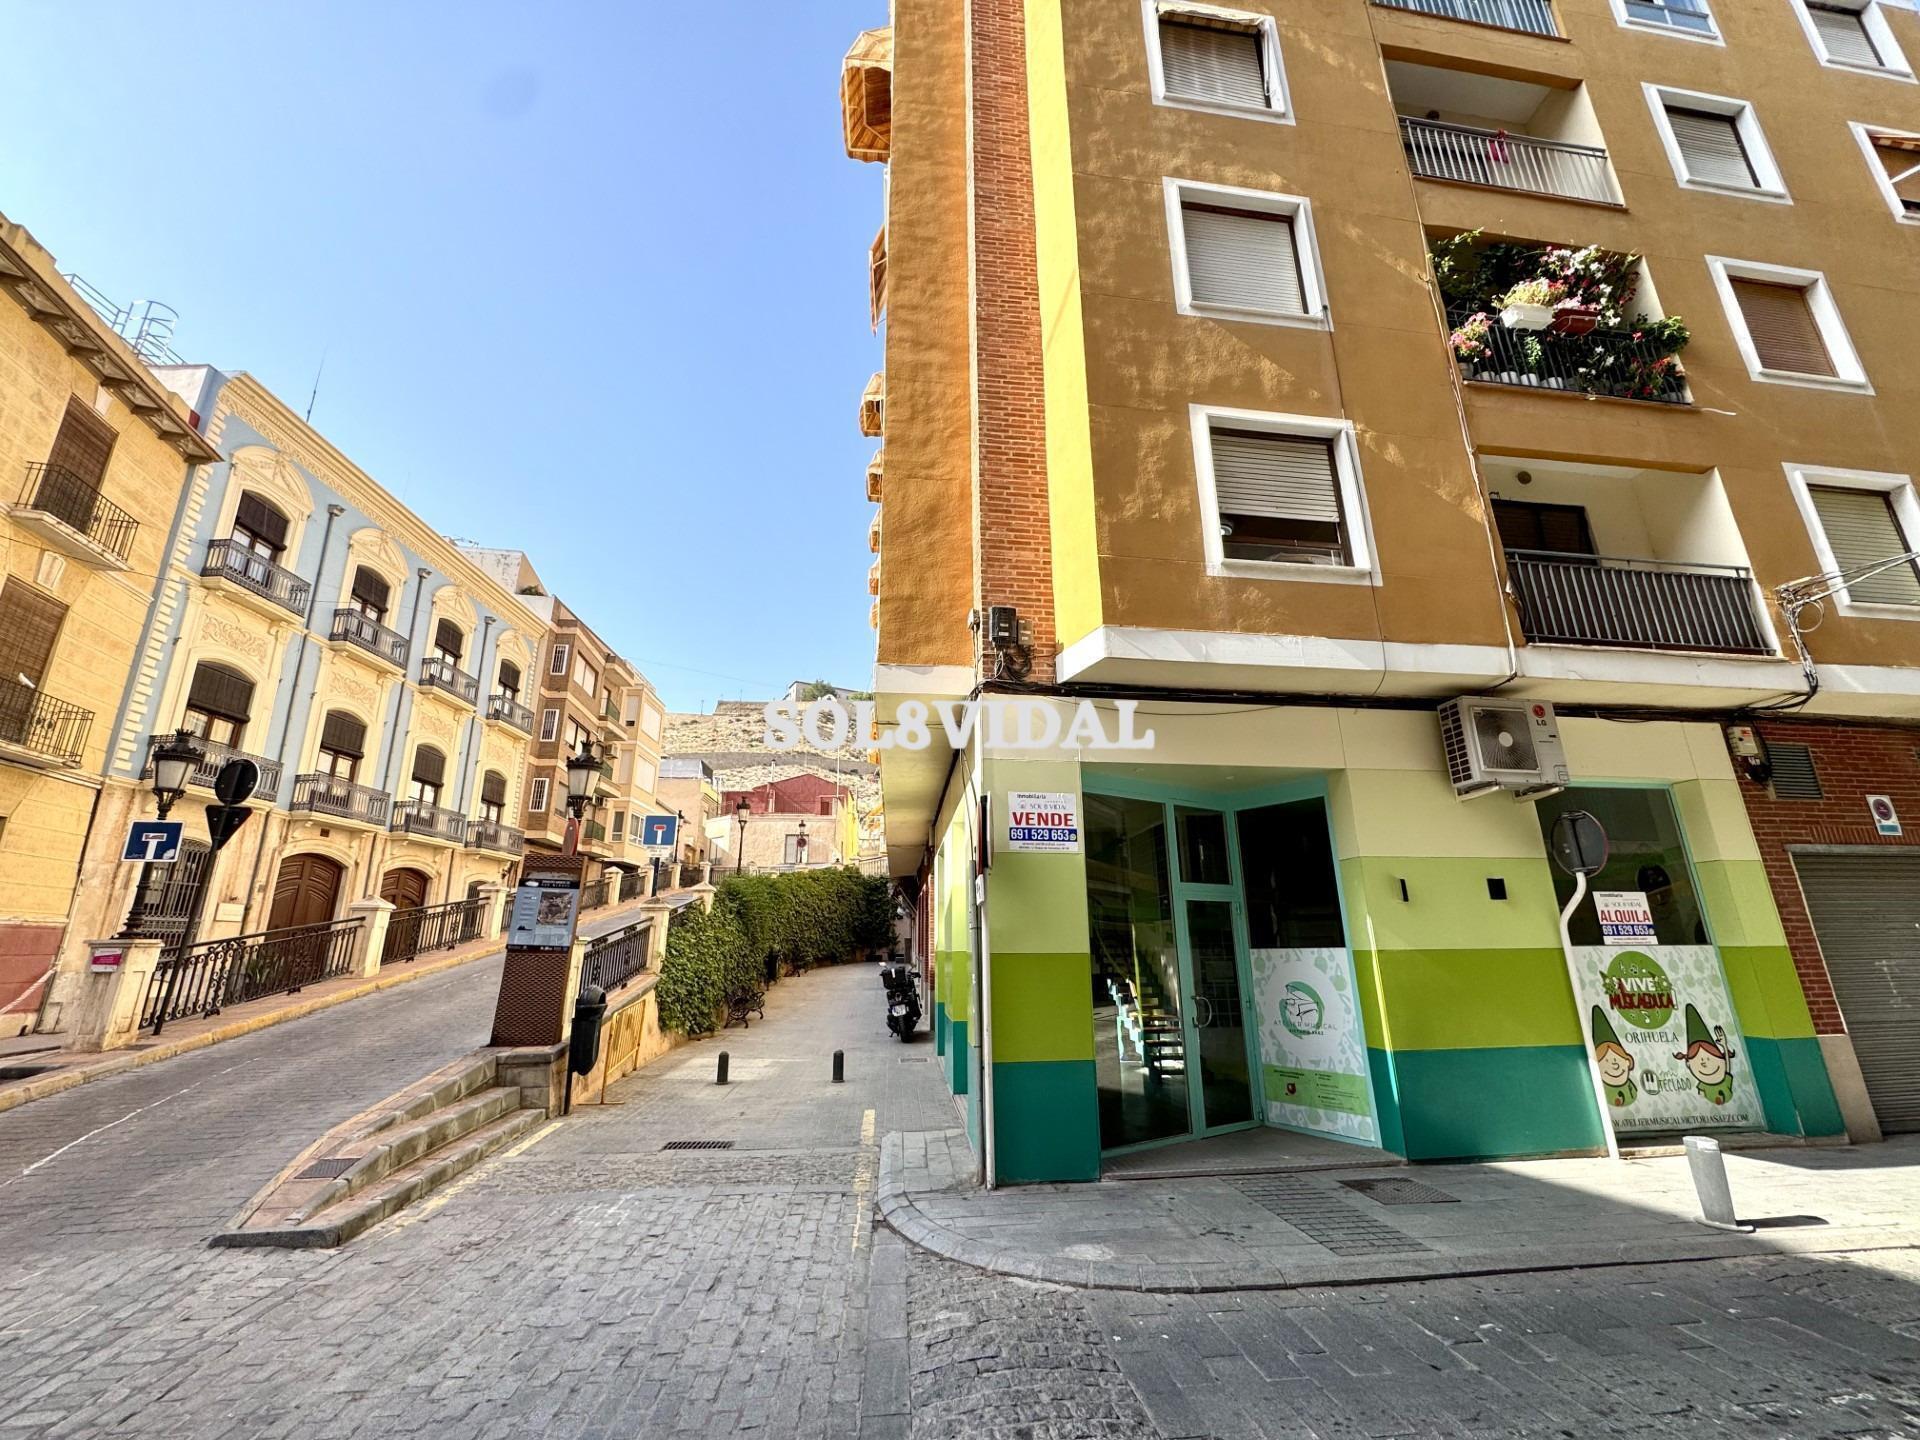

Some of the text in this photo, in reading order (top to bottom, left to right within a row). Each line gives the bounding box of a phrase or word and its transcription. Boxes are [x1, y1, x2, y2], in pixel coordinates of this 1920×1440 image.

[1012, 811, 1074, 827] VENDE
[1010, 828, 1069, 841] 691 529 653
[1600, 909, 1651, 923] ALQUILA
[1602, 925, 1649, 935] 691 529 653
[1624, 1031, 1679, 1044] ORIHUELA
[1658, 1077, 1692, 1092] TECLADO
